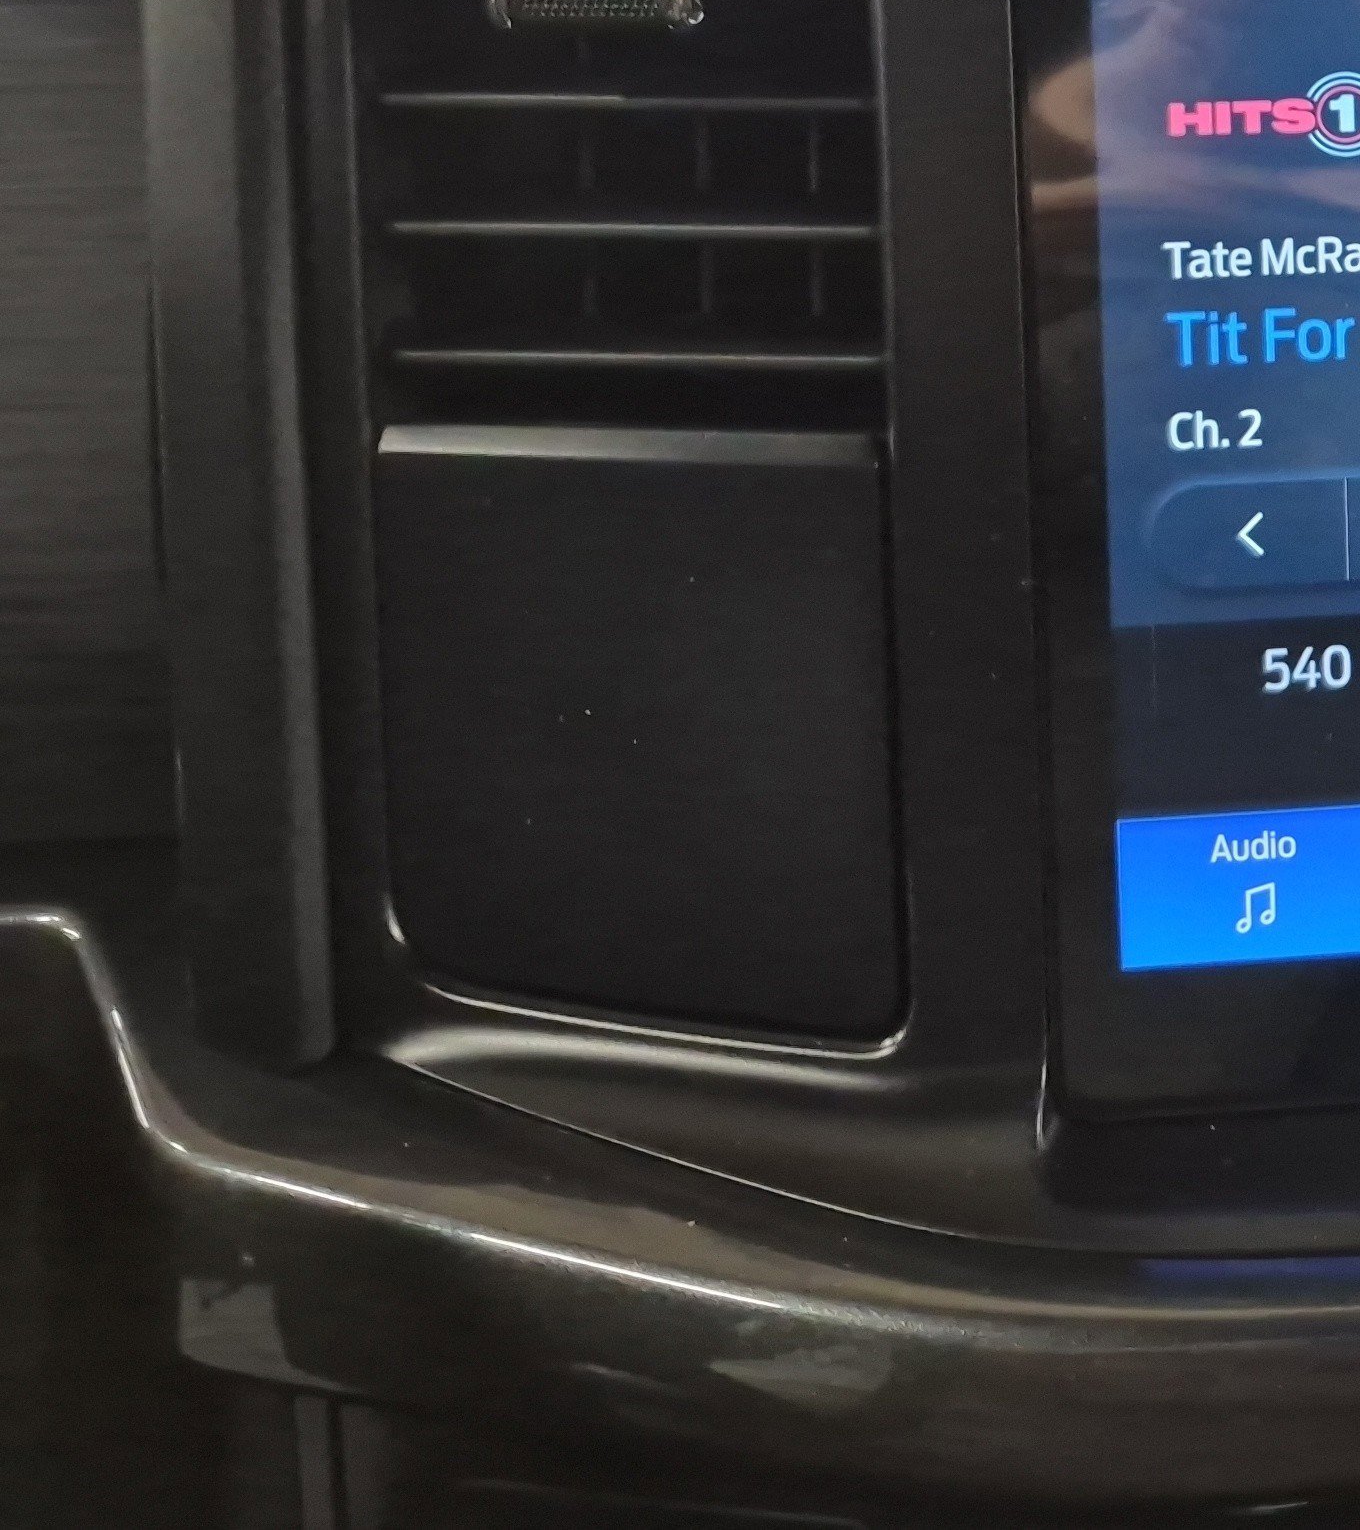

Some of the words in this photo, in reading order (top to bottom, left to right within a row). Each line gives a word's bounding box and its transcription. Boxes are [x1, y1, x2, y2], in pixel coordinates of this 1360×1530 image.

[1162, 239, 1253, 280] Tate
[1163, 310, 1249, 368] Tit
[1262, 307, 1355, 363] For
[1167, 411, 1231, 452] Ch.
[1238, 408, 1264, 448] 2
[1261, 644, 1352, 694] 540
[1210, 829, 1298, 865] Audio
